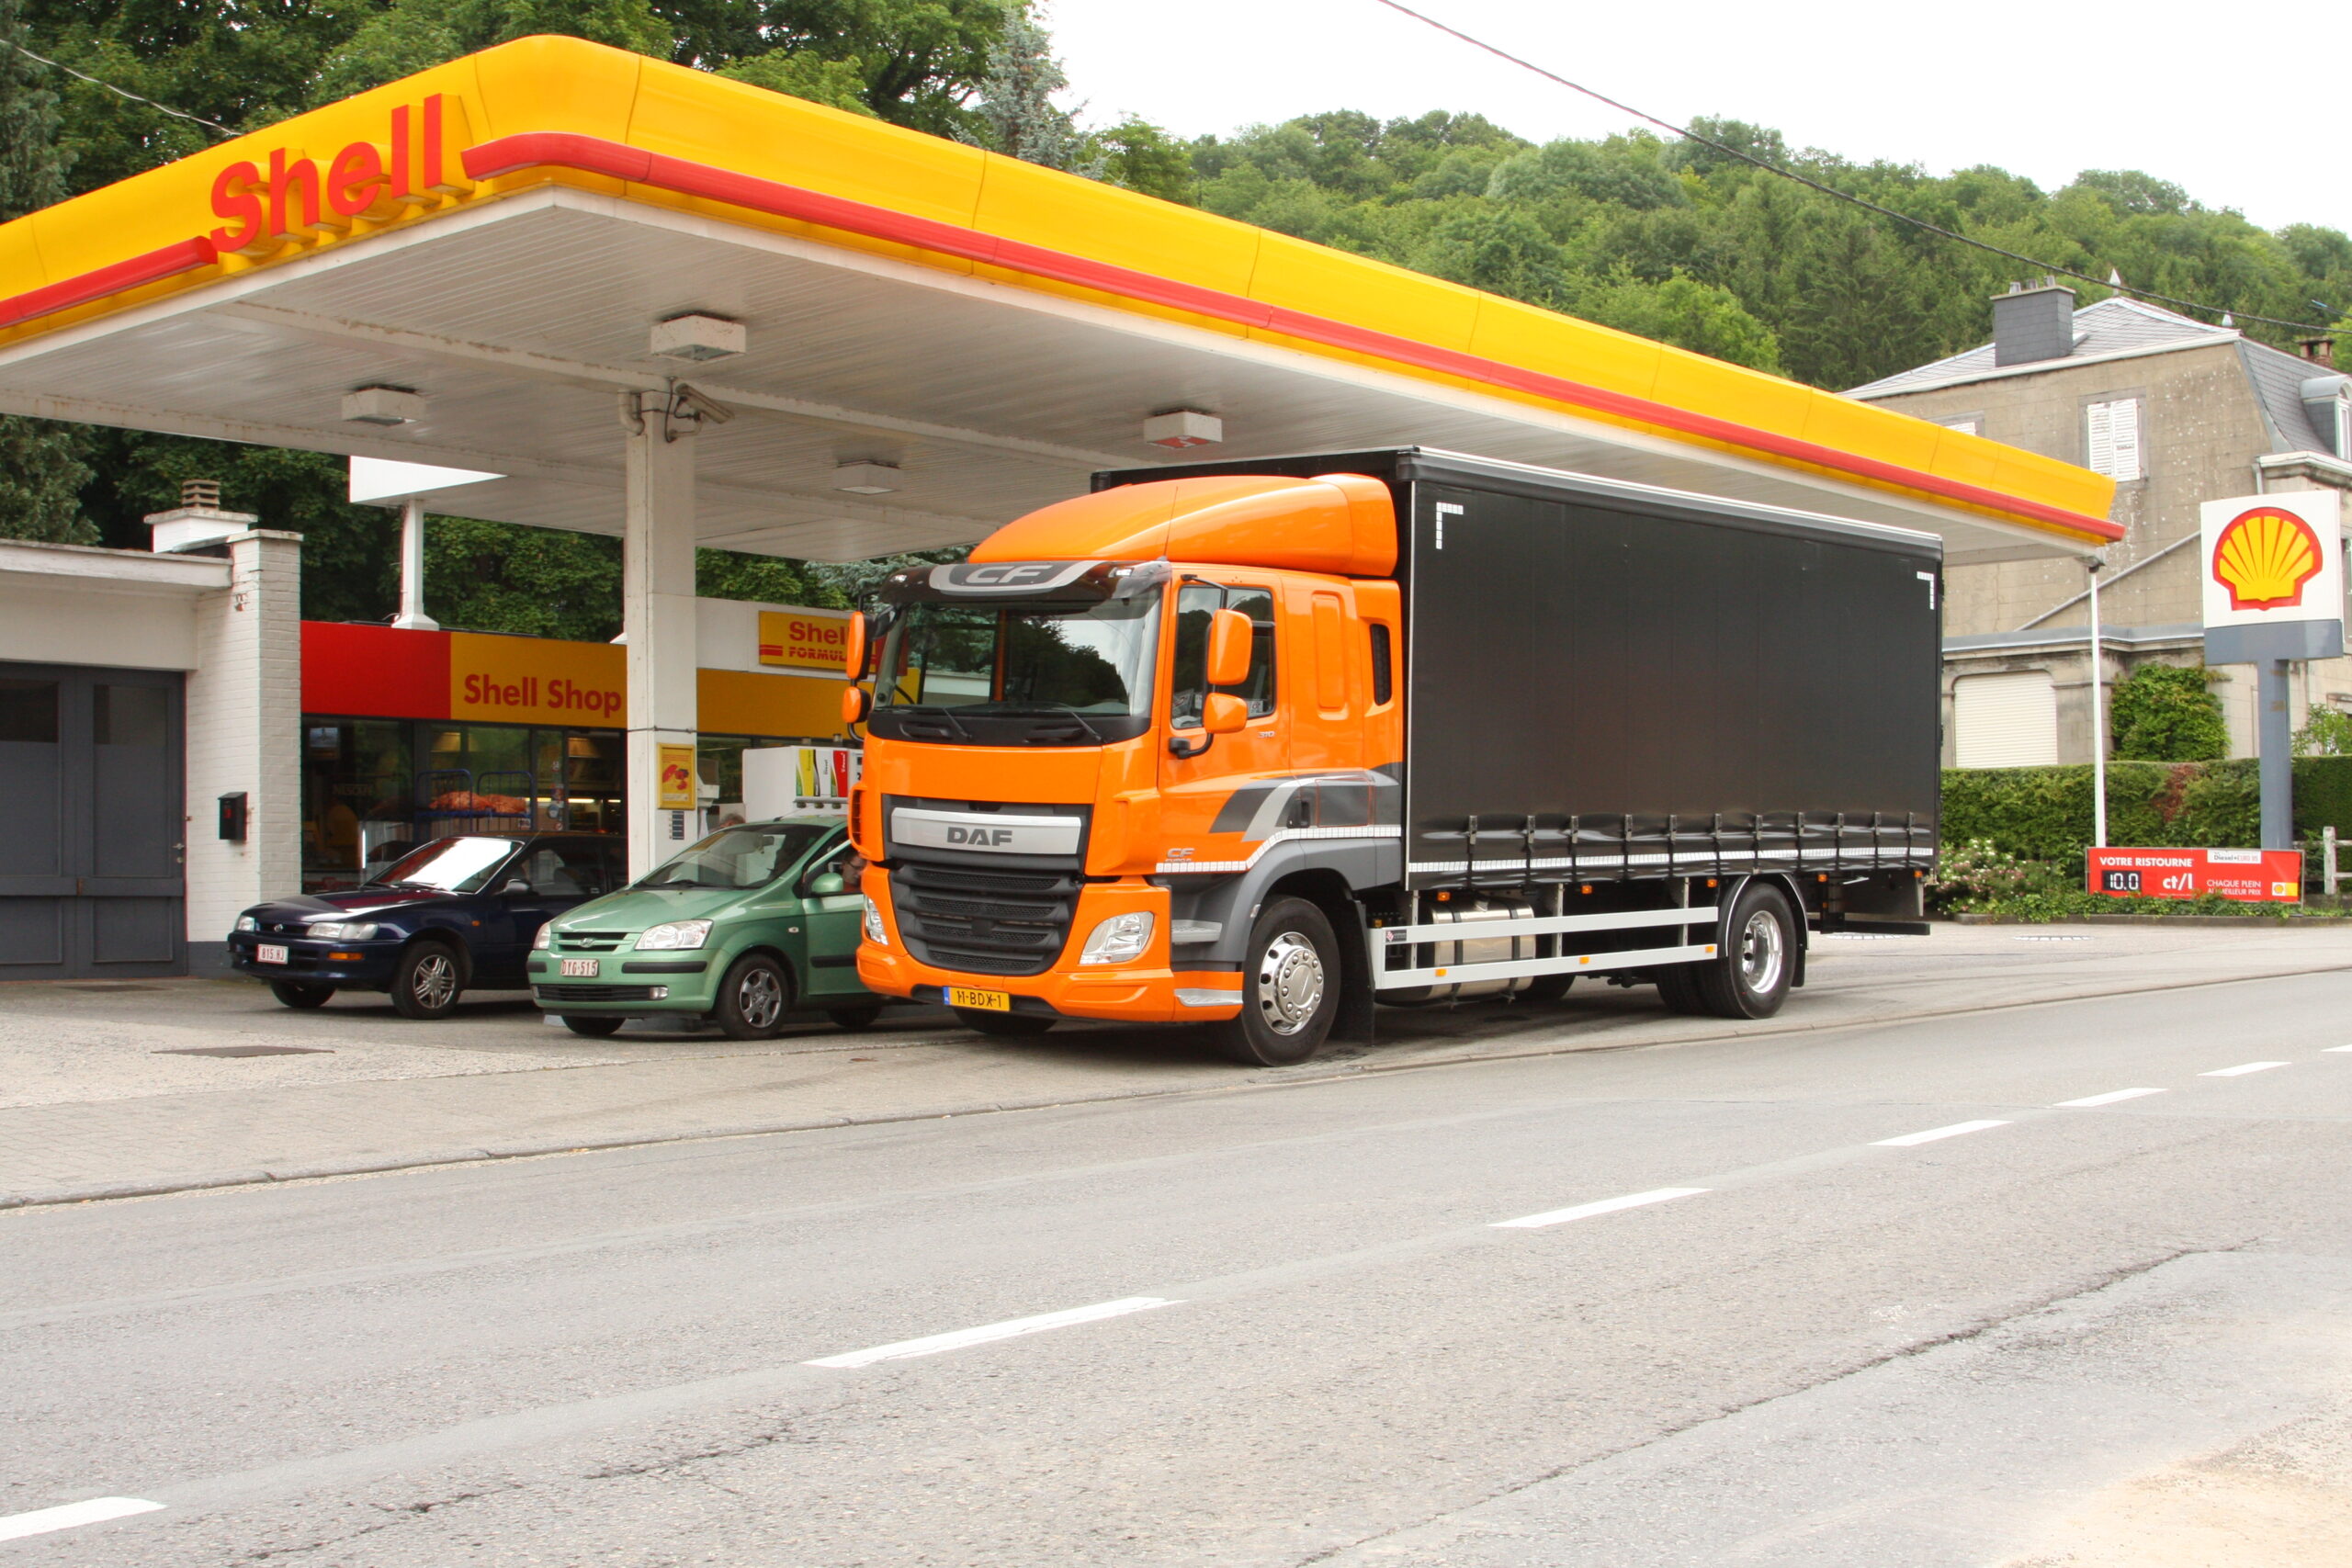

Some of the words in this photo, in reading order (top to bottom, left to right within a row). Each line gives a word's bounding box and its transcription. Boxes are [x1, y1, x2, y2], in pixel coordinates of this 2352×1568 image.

[209, 93, 442, 253] Shell
[966, 565, 1053, 583] CF
[464, 673, 537, 706] Shell
[548, 679, 622, 718] Shop
[946, 827, 1012, 846] DAF
[1167, 848, 1195, 858] CF
[2099, 856, 2132, 866] VOTRE
[2162, 873, 2193, 890] ct/l
[2206, 879, 2240, 887] CHAQUE
[2241, 880, 2262, 888] PLEIN
